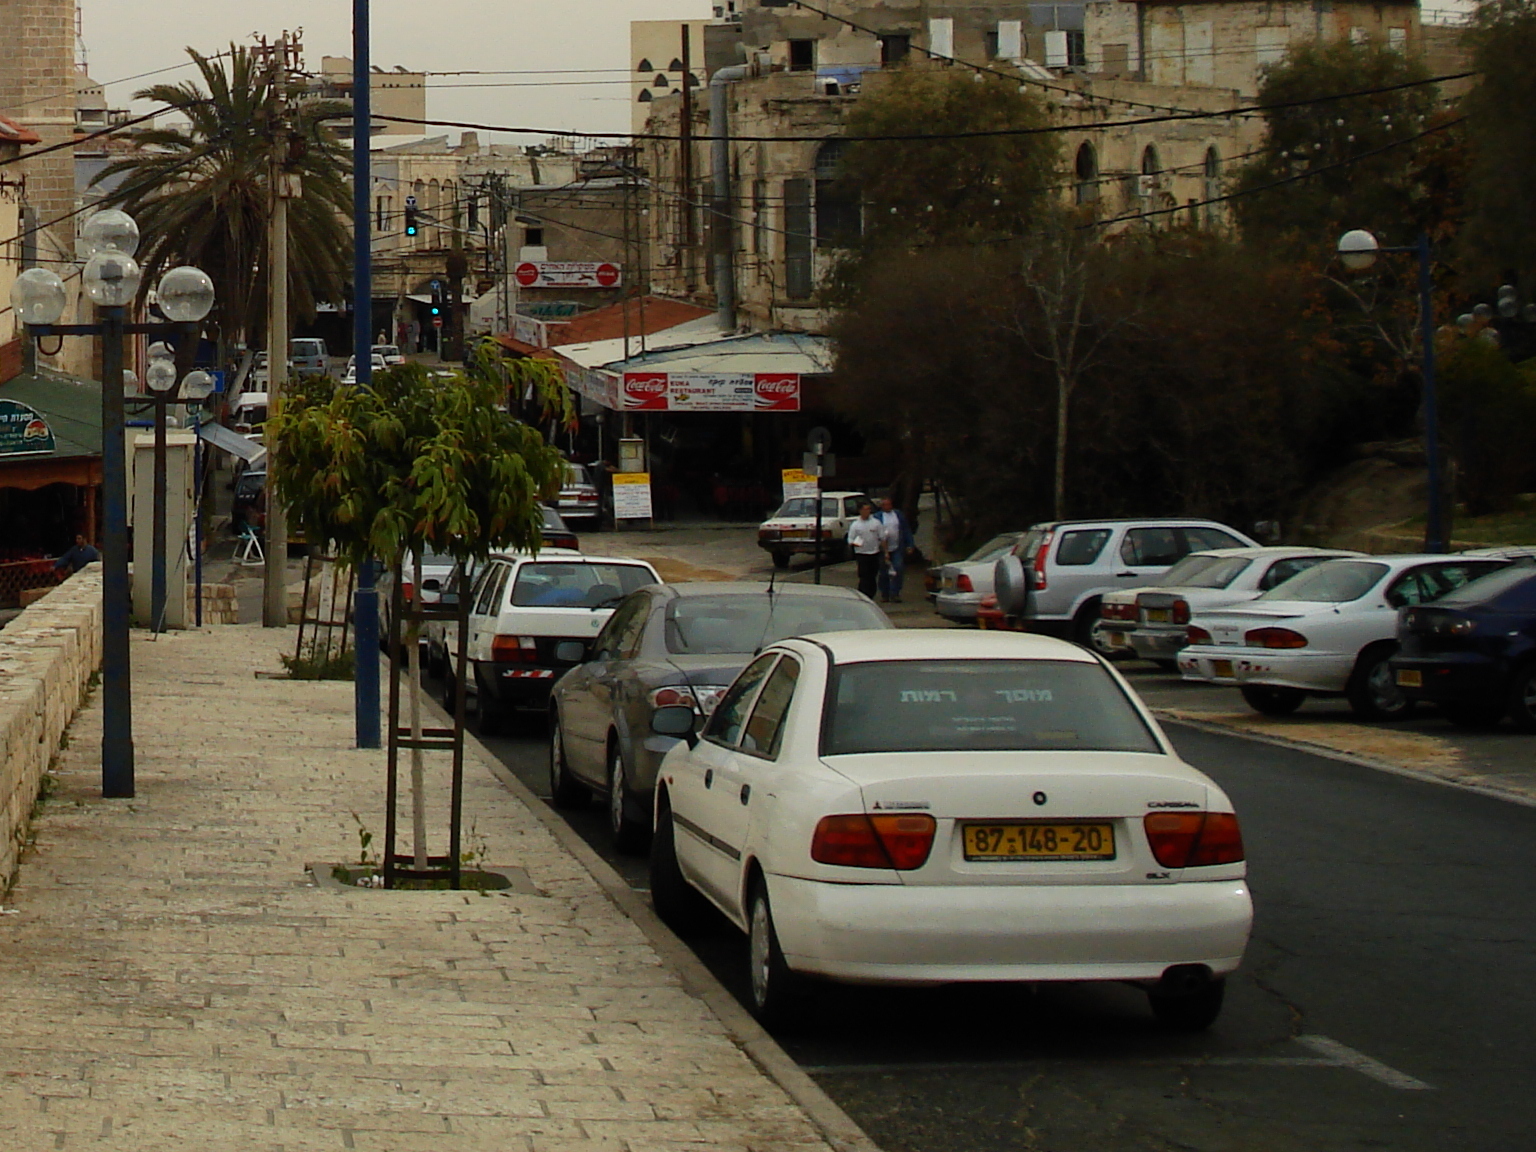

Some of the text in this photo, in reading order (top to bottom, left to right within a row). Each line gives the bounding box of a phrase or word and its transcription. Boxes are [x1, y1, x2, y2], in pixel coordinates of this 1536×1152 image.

[900, 689, 1053, 703] מוסך רמות
[975, 827, 1102, 852] 87-148-20
